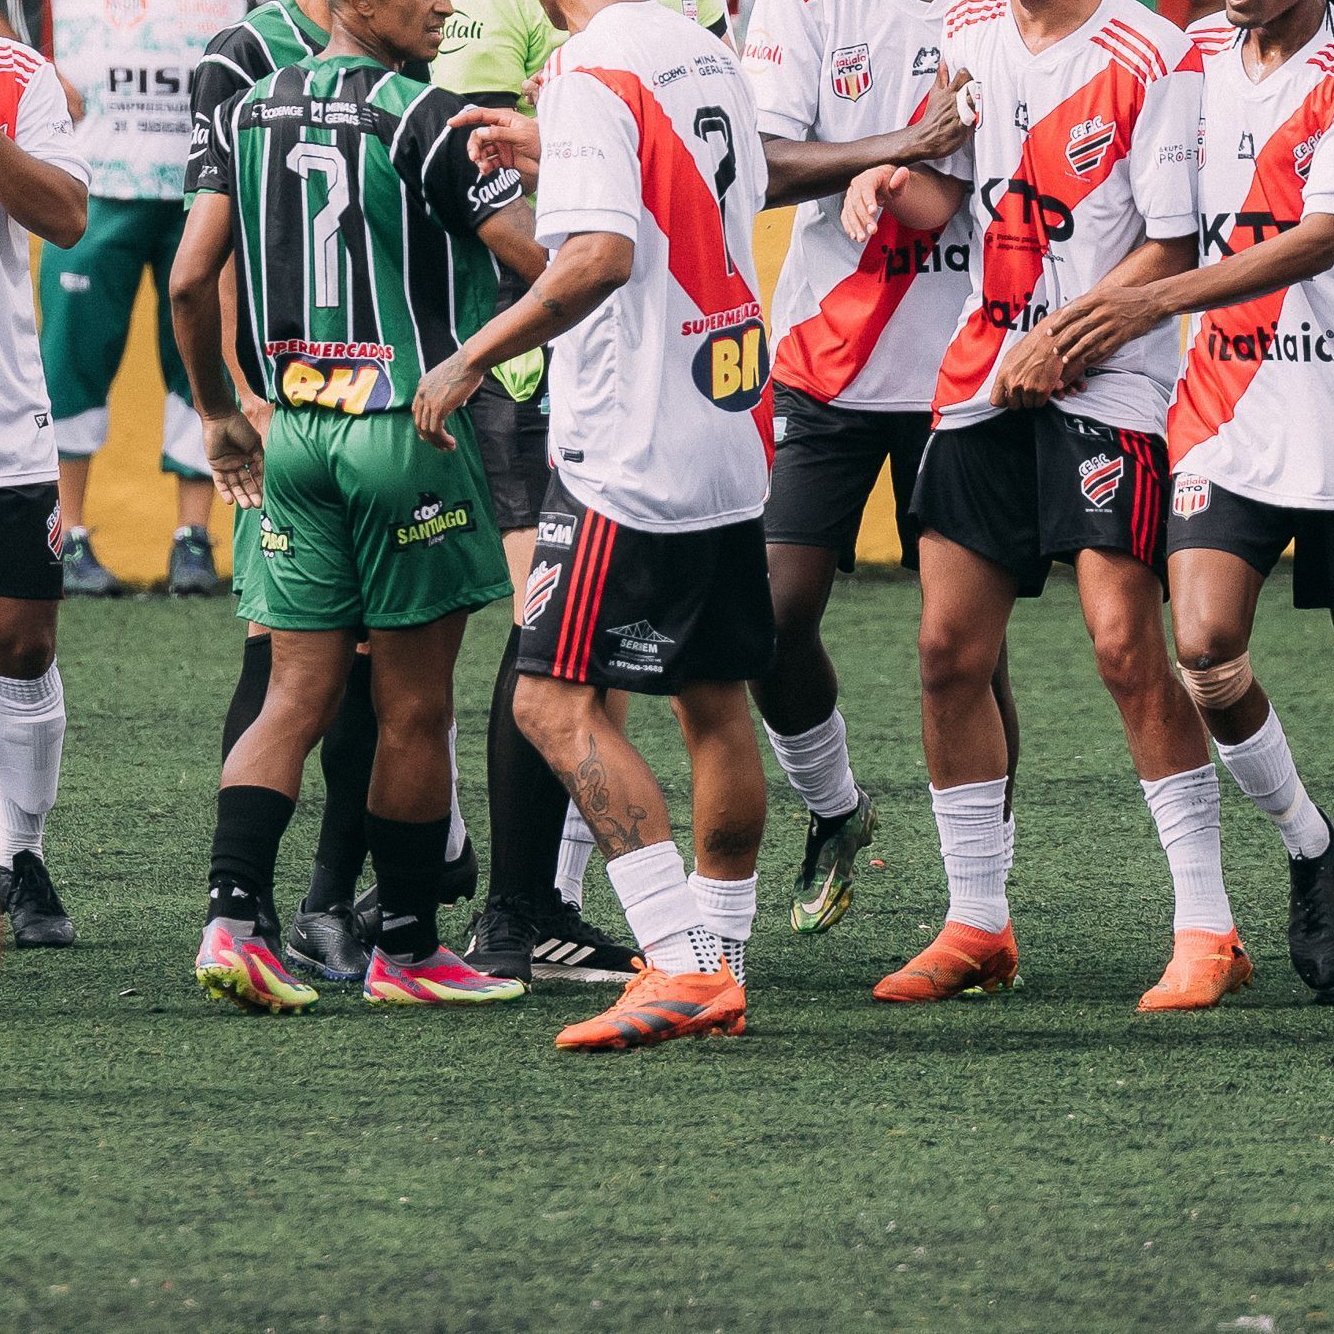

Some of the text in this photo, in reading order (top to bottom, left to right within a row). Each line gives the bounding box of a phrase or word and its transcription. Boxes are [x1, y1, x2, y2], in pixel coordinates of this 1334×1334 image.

[444, 20, 484, 40] dali
[325, 102, 358, 114] MINAS
[547, 145, 605, 160] PROJETA
[285, 141, 350, 308] 7
[1201, 212, 1301, 256] KT
[264, 339, 394, 360] UPERMERCADOS
[282, 359, 379, 415] BH
[1178, 485, 1203, 494] KTO
[397, 509, 467, 545] SANTIAGO
